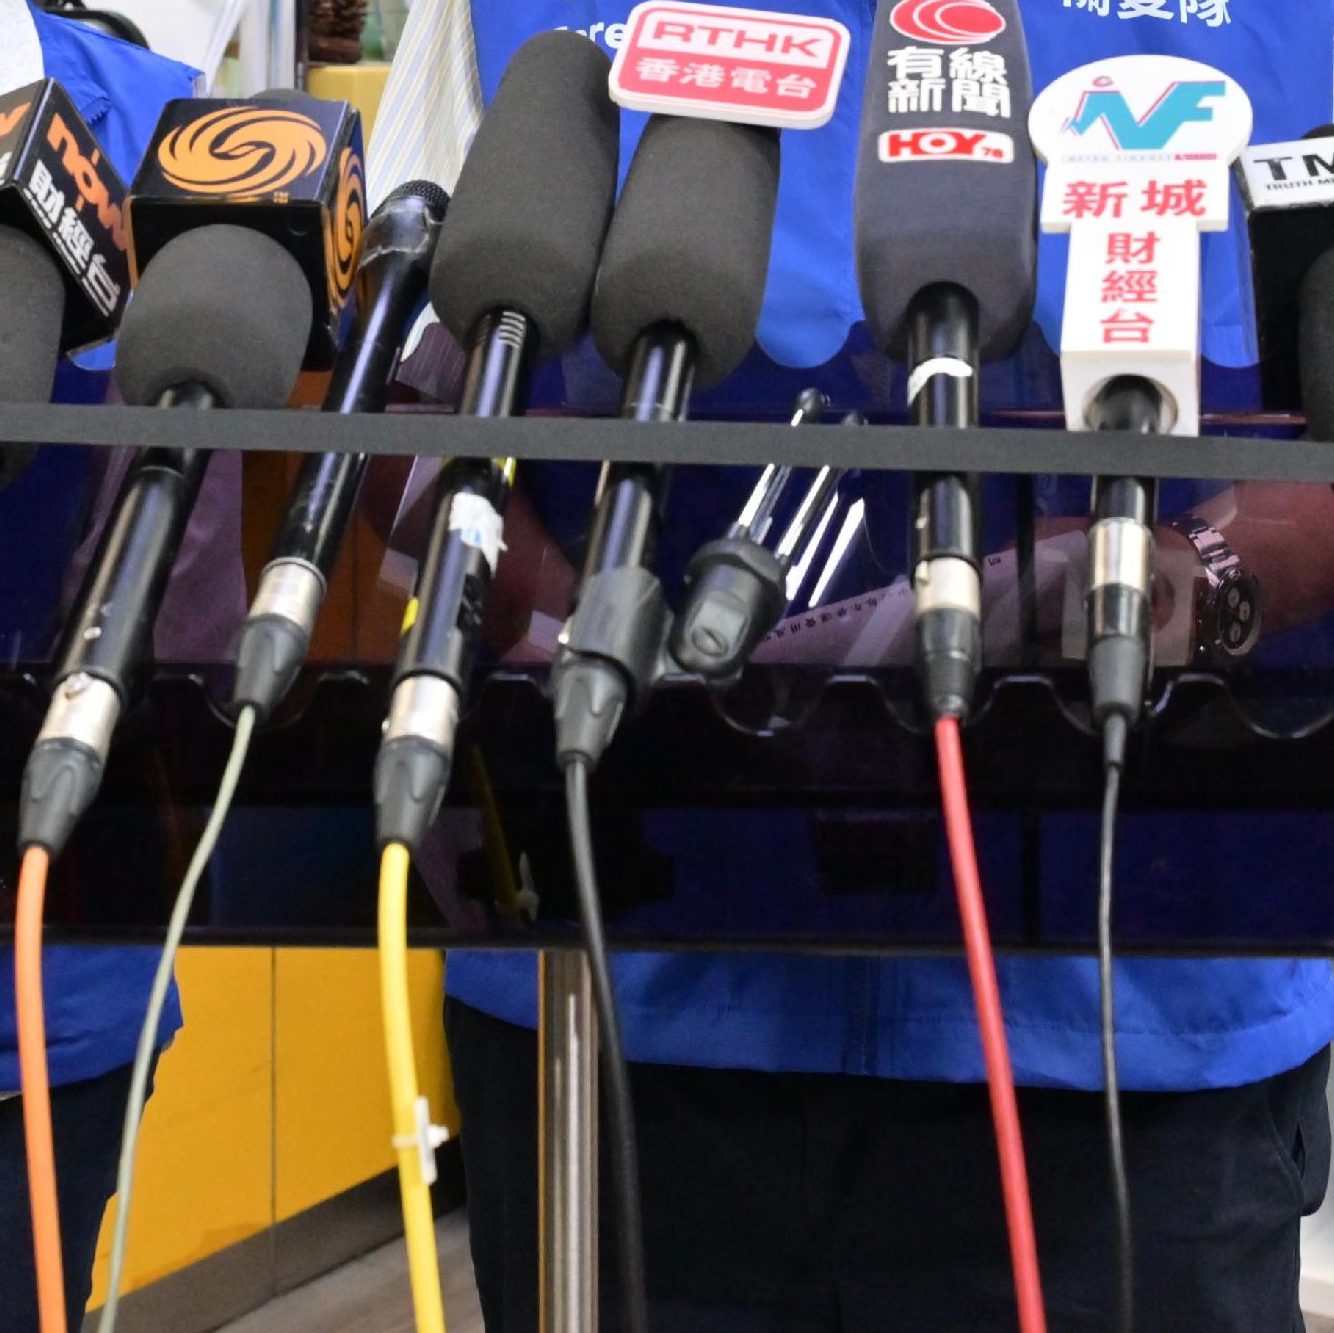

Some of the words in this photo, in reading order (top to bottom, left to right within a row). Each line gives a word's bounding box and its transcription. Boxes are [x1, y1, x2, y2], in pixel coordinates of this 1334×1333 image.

[652, 21, 822, 58] RTHK
[636, 57, 816, 99] 香港電台
[887, 46, 1007, 85] 有線
[888, 78, 1011, 119] 新聞
[888, 131, 987, 157] HOY
[47, 113, 128, 251] now
[1062, 179, 1207, 219] 新城
[1267, 180, 1313, 191] TRUTH
[28, 159, 120, 313] 財經台
[1100, 231, 1160, 344] 財經台
